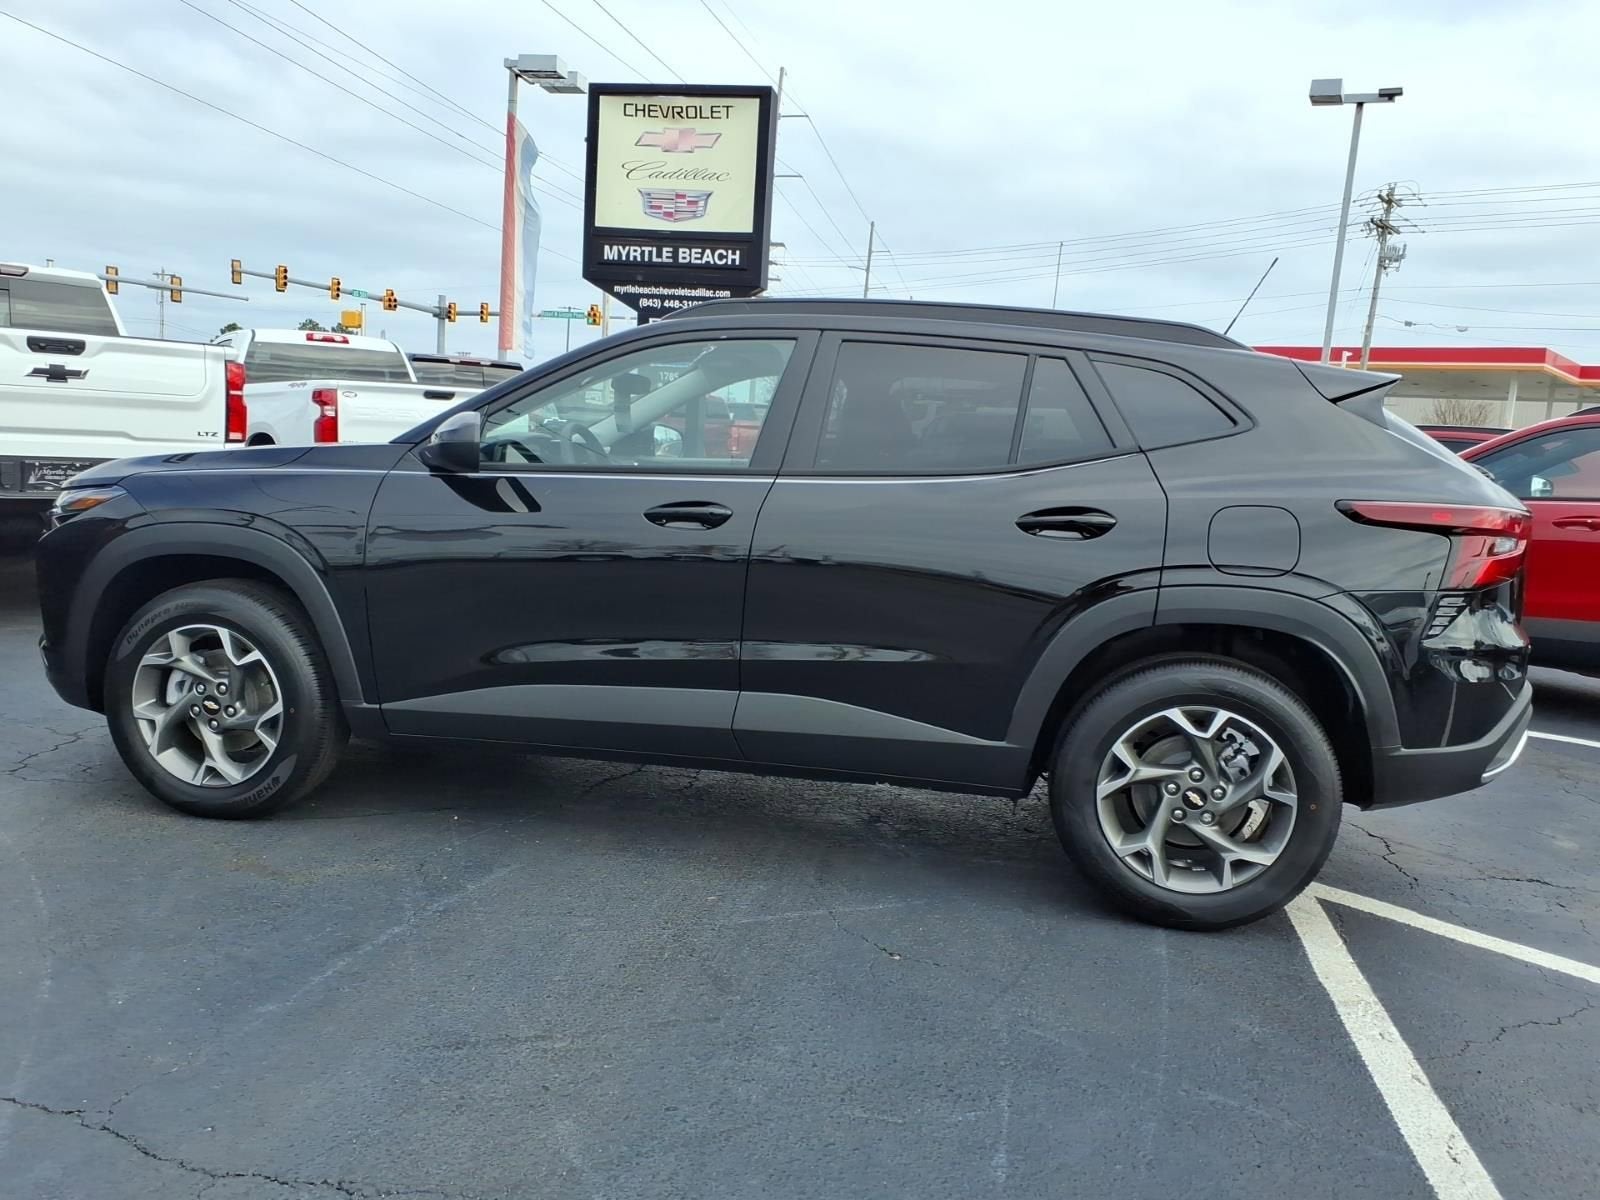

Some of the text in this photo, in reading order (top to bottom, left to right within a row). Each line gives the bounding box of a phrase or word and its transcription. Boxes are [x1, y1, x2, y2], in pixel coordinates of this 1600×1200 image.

[623, 103, 734, 119] CHEVROLET
[621, 160, 731, 182] Cadillac
[603, 245, 740, 265] MYRTLE BEACH
[613, 284, 731, 298] myrtlebeachchevroletcadillac.com
[639, 298, 661, 309] (843)
